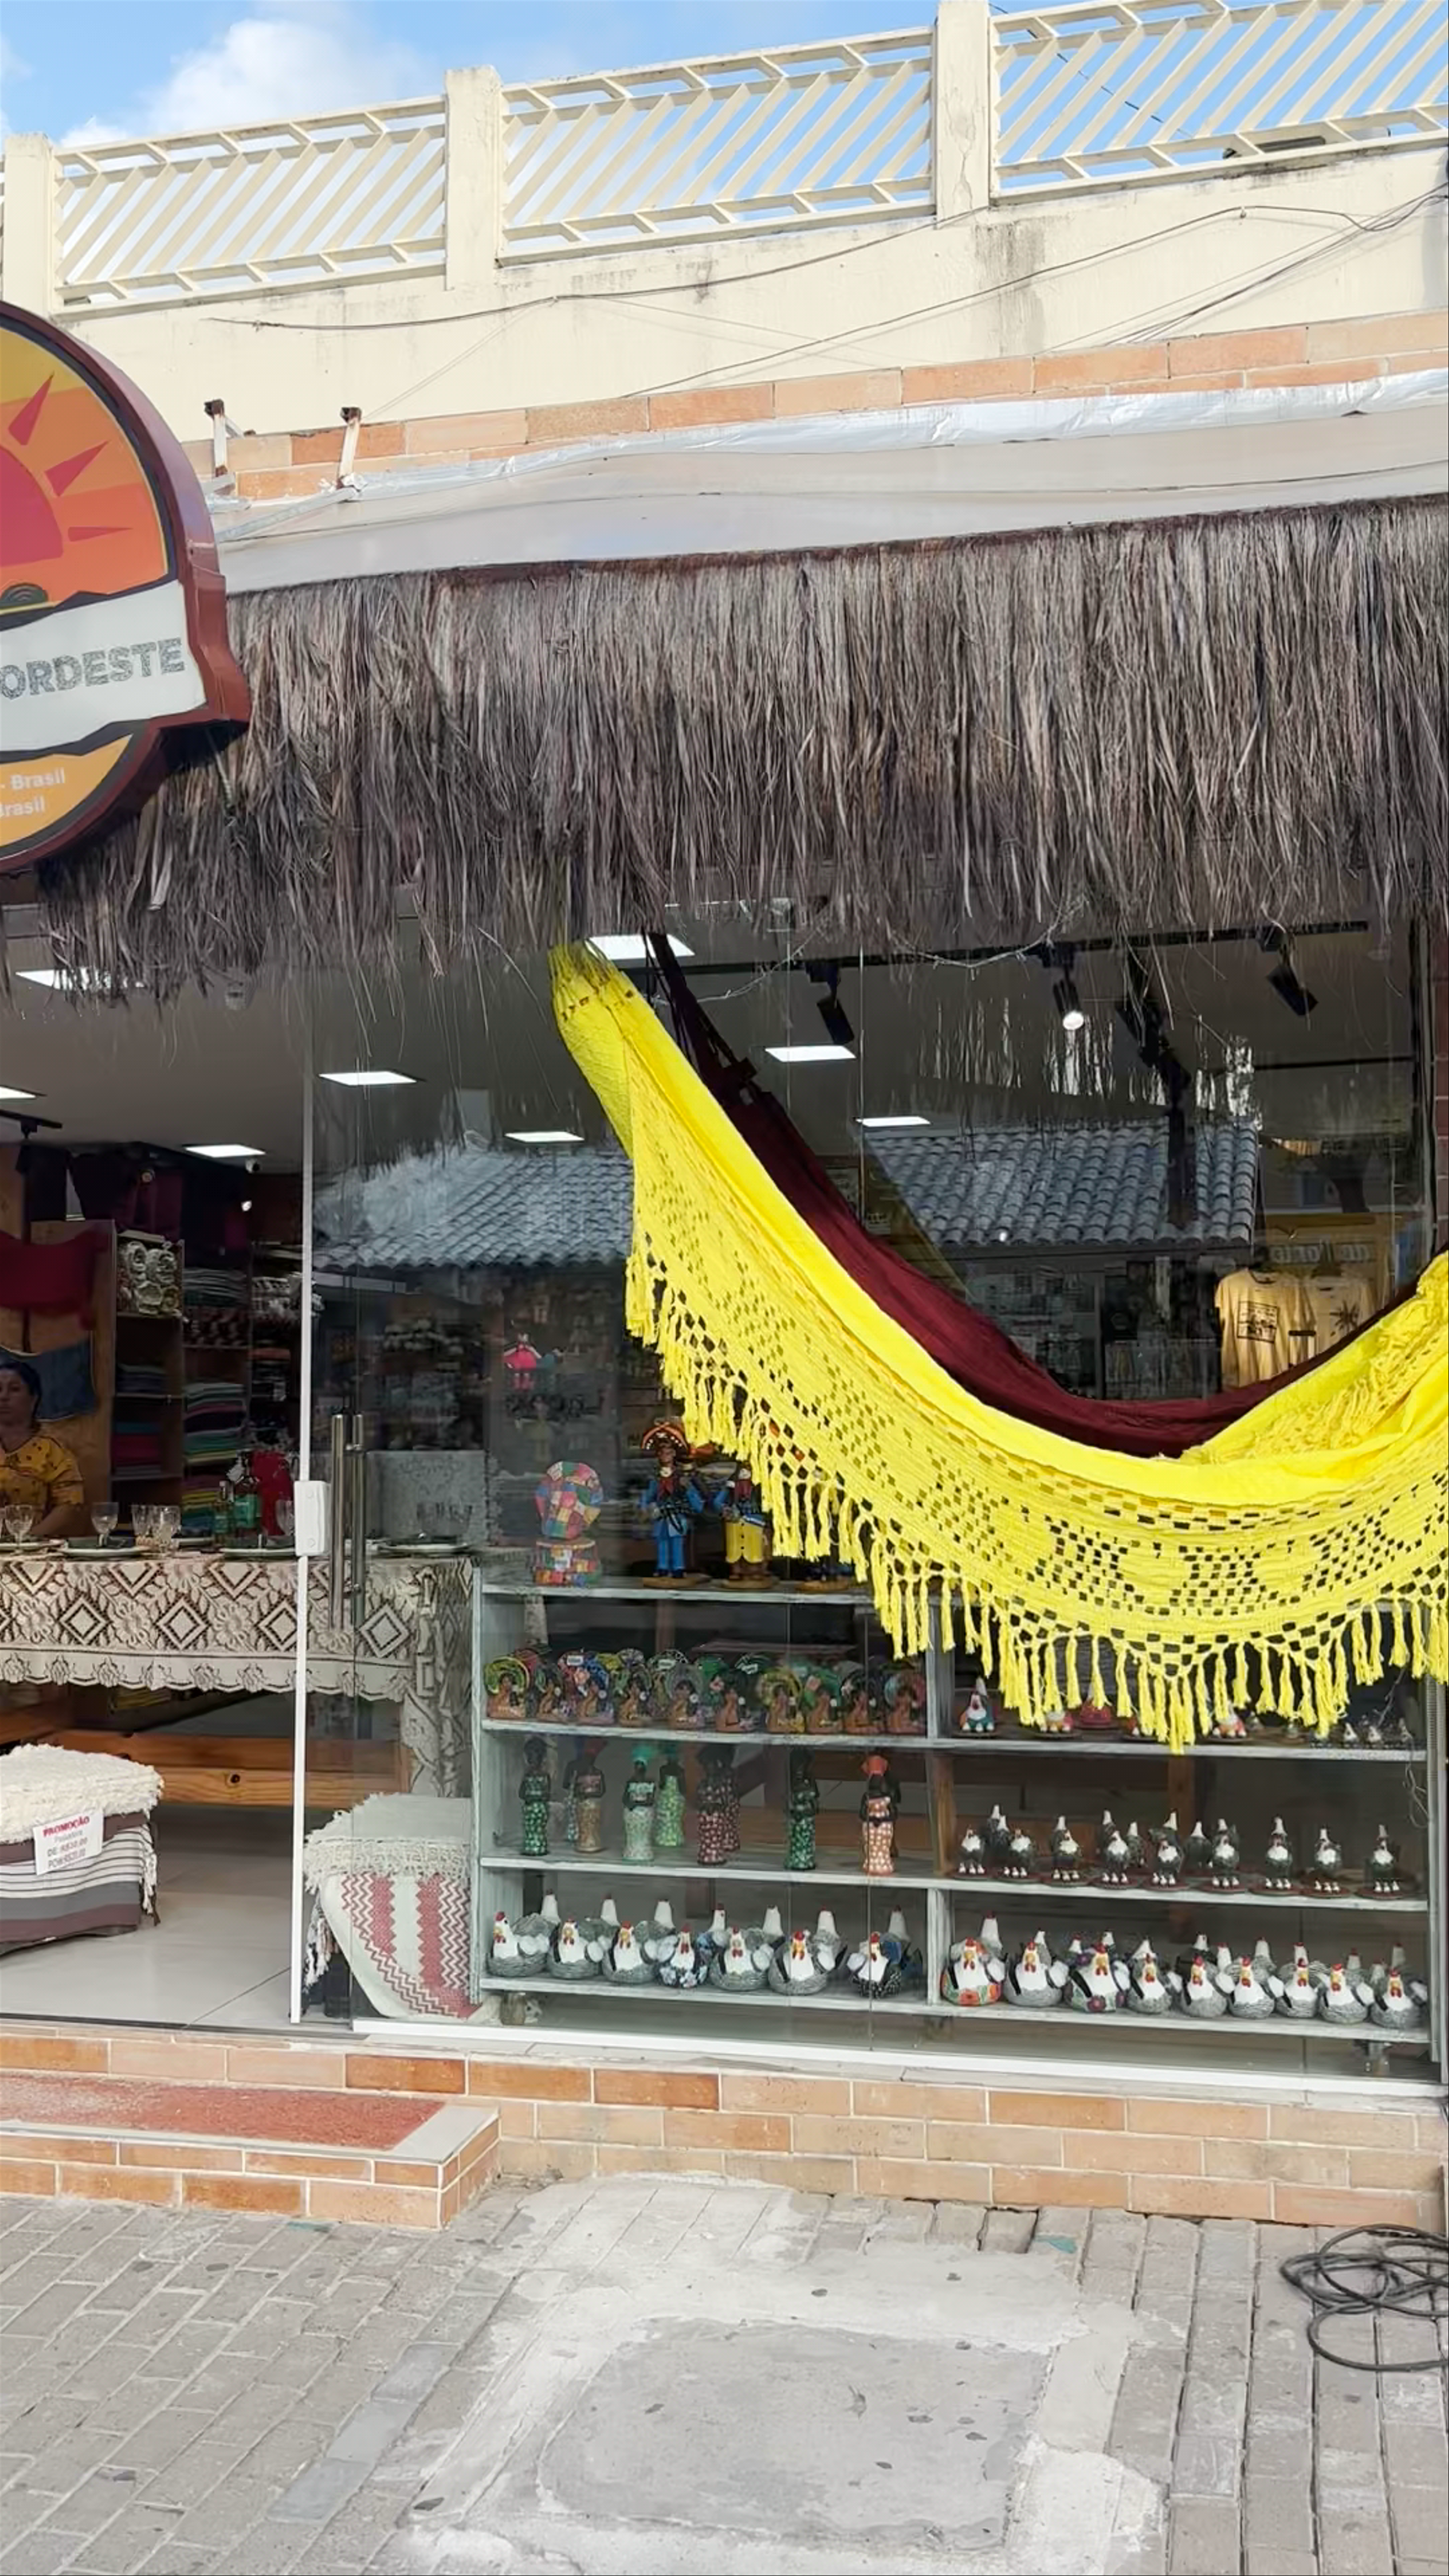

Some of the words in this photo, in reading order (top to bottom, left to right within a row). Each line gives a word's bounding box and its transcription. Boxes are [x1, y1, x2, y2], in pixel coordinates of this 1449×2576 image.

[0, 638, 185, 699] ORDESTE
[11, 768, 65, 789] Brasil
[43, 1816, 89, 1837] PROMOÇÃO
